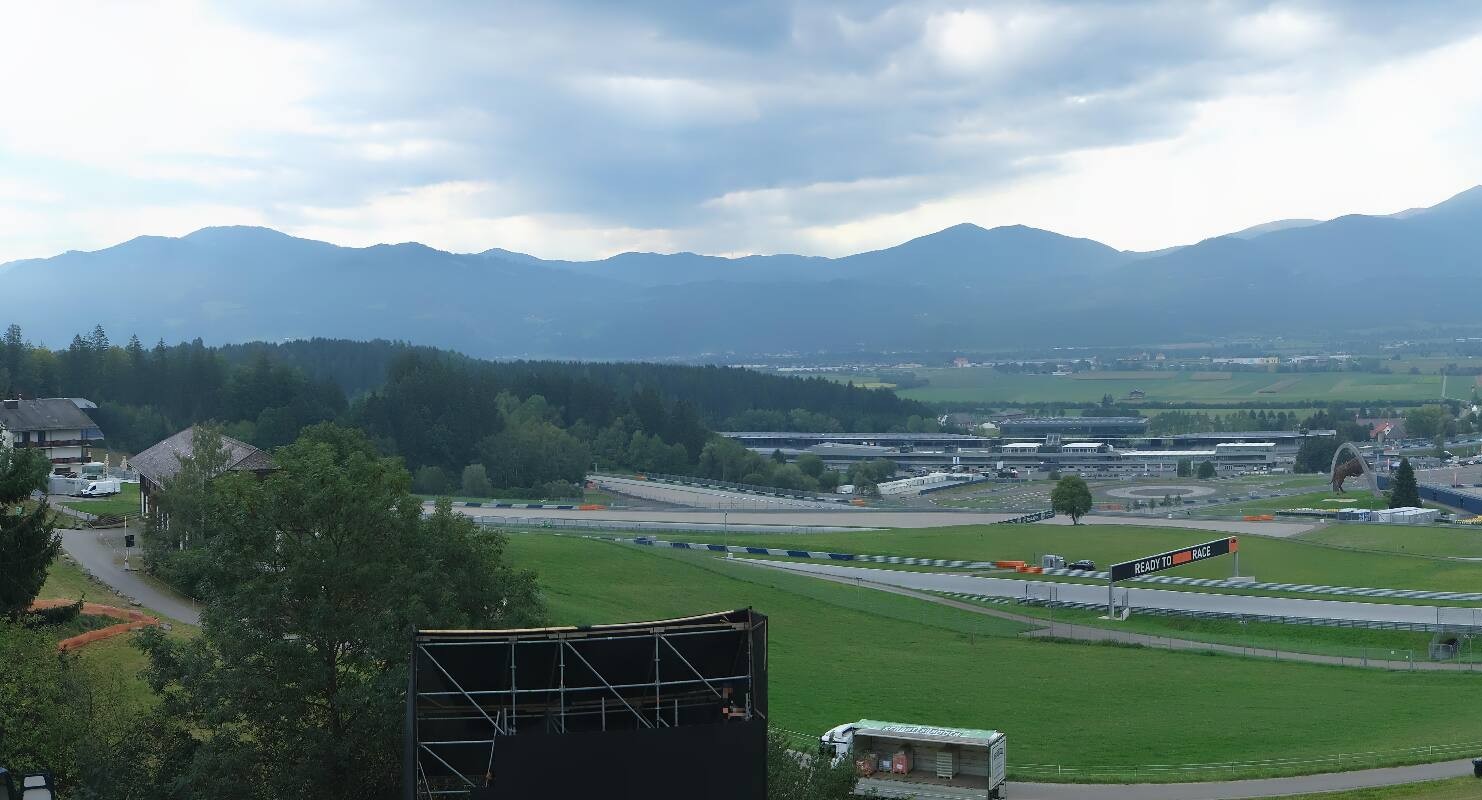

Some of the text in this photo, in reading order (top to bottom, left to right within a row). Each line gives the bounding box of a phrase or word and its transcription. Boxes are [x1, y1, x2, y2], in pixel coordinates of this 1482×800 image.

[1134, 546, 1211, 574] READY TO RACE
